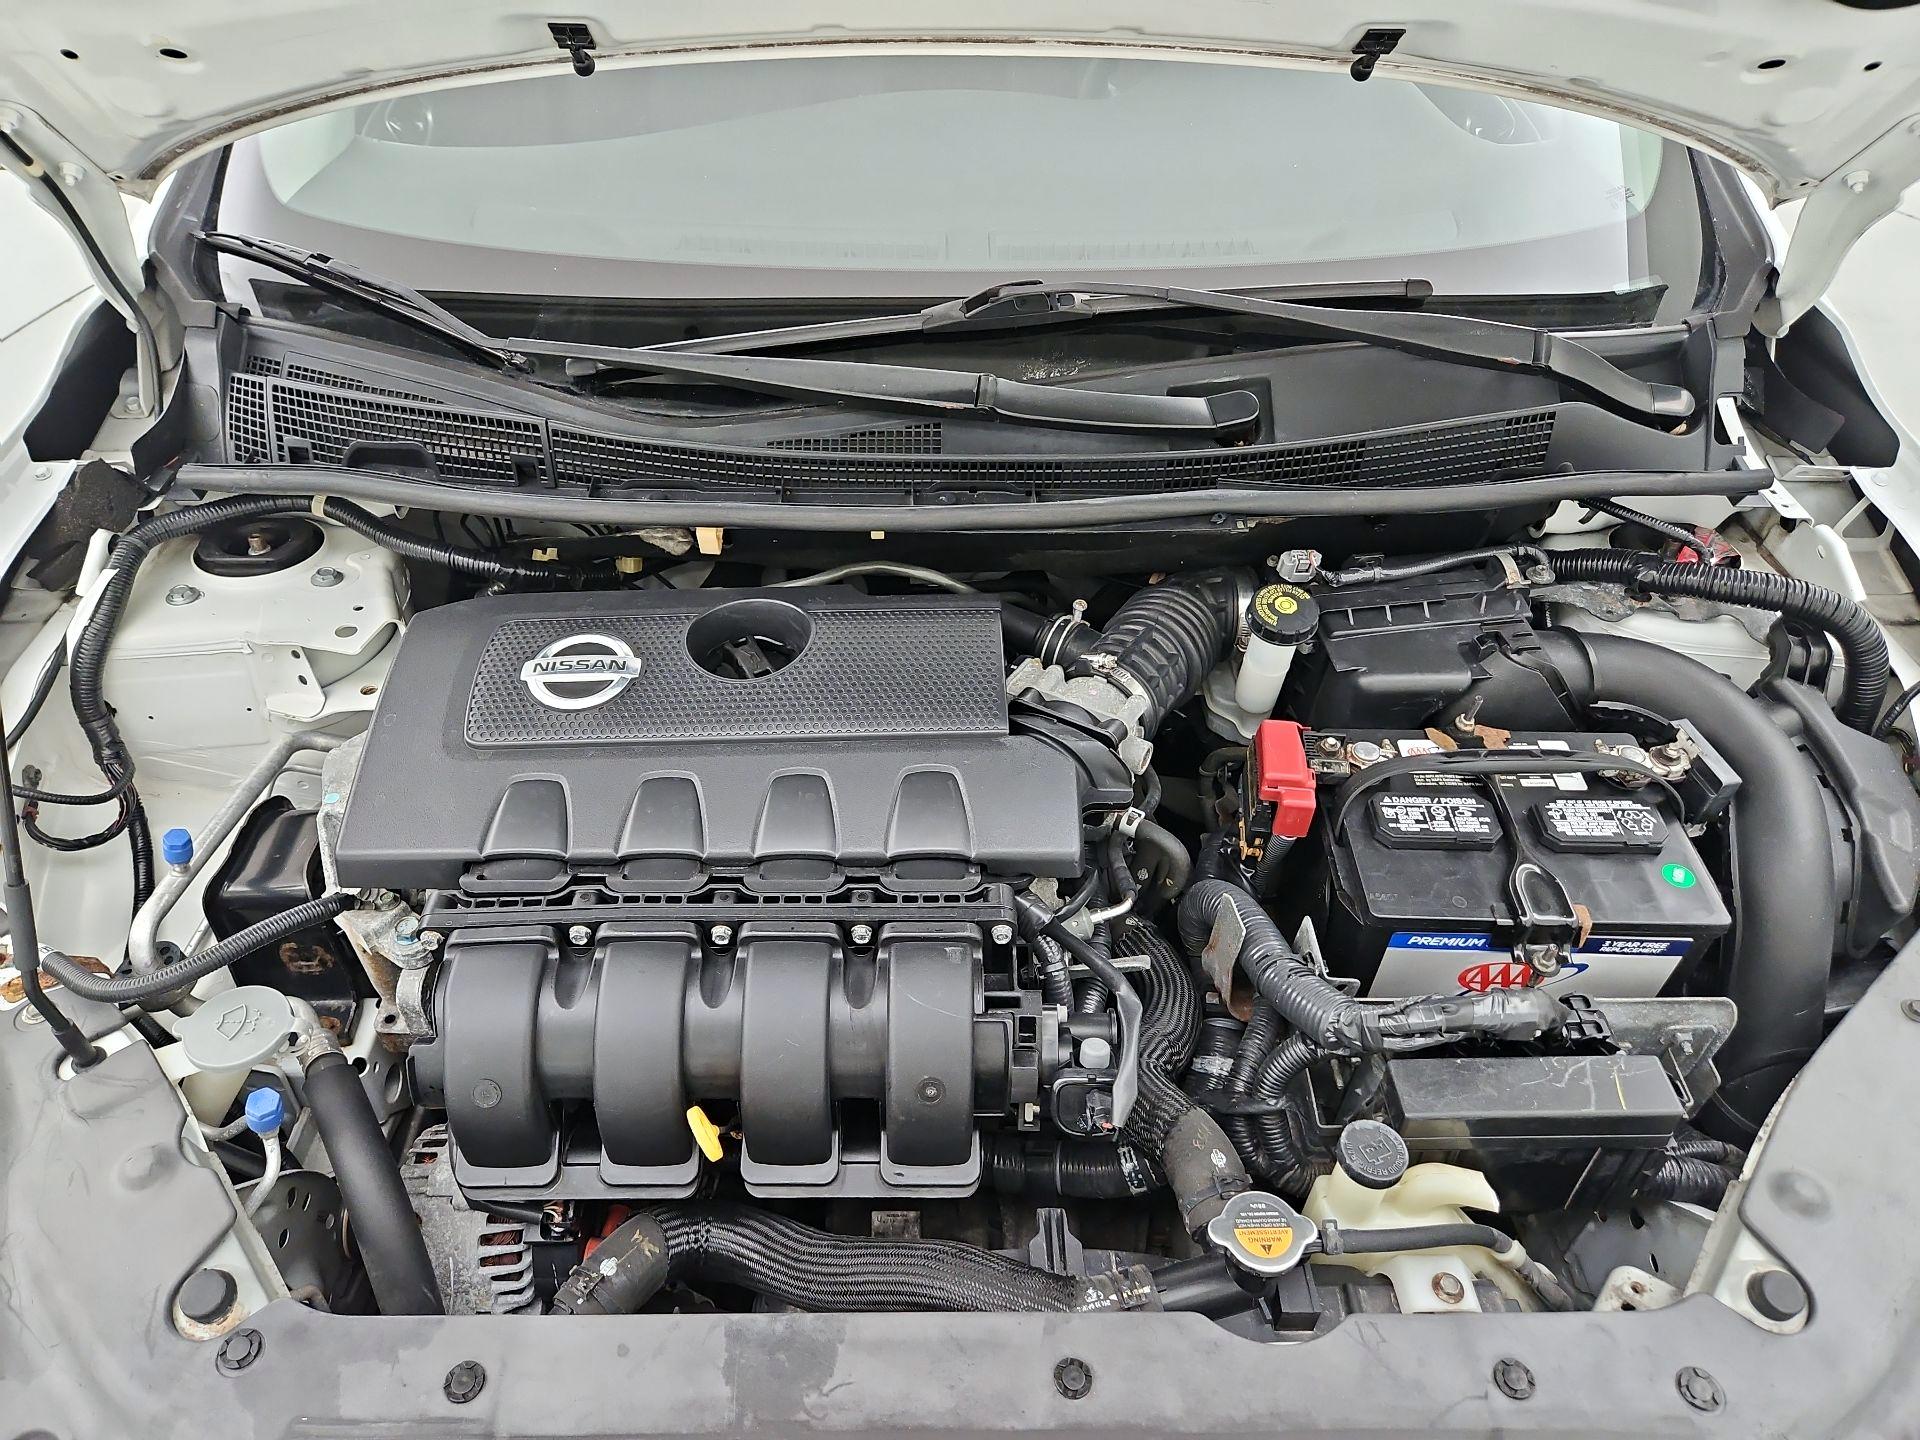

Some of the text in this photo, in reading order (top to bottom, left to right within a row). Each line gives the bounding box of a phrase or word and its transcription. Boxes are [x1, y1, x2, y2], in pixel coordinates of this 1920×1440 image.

[533, 660, 627, 673] NISSAN
[1392, 796, 1432, 804] DANGER
[1441, 797, 1477, 805] POISON
[1407, 936, 1487, 947] PREMIUM
[1458, 962, 1537, 992] AAA
